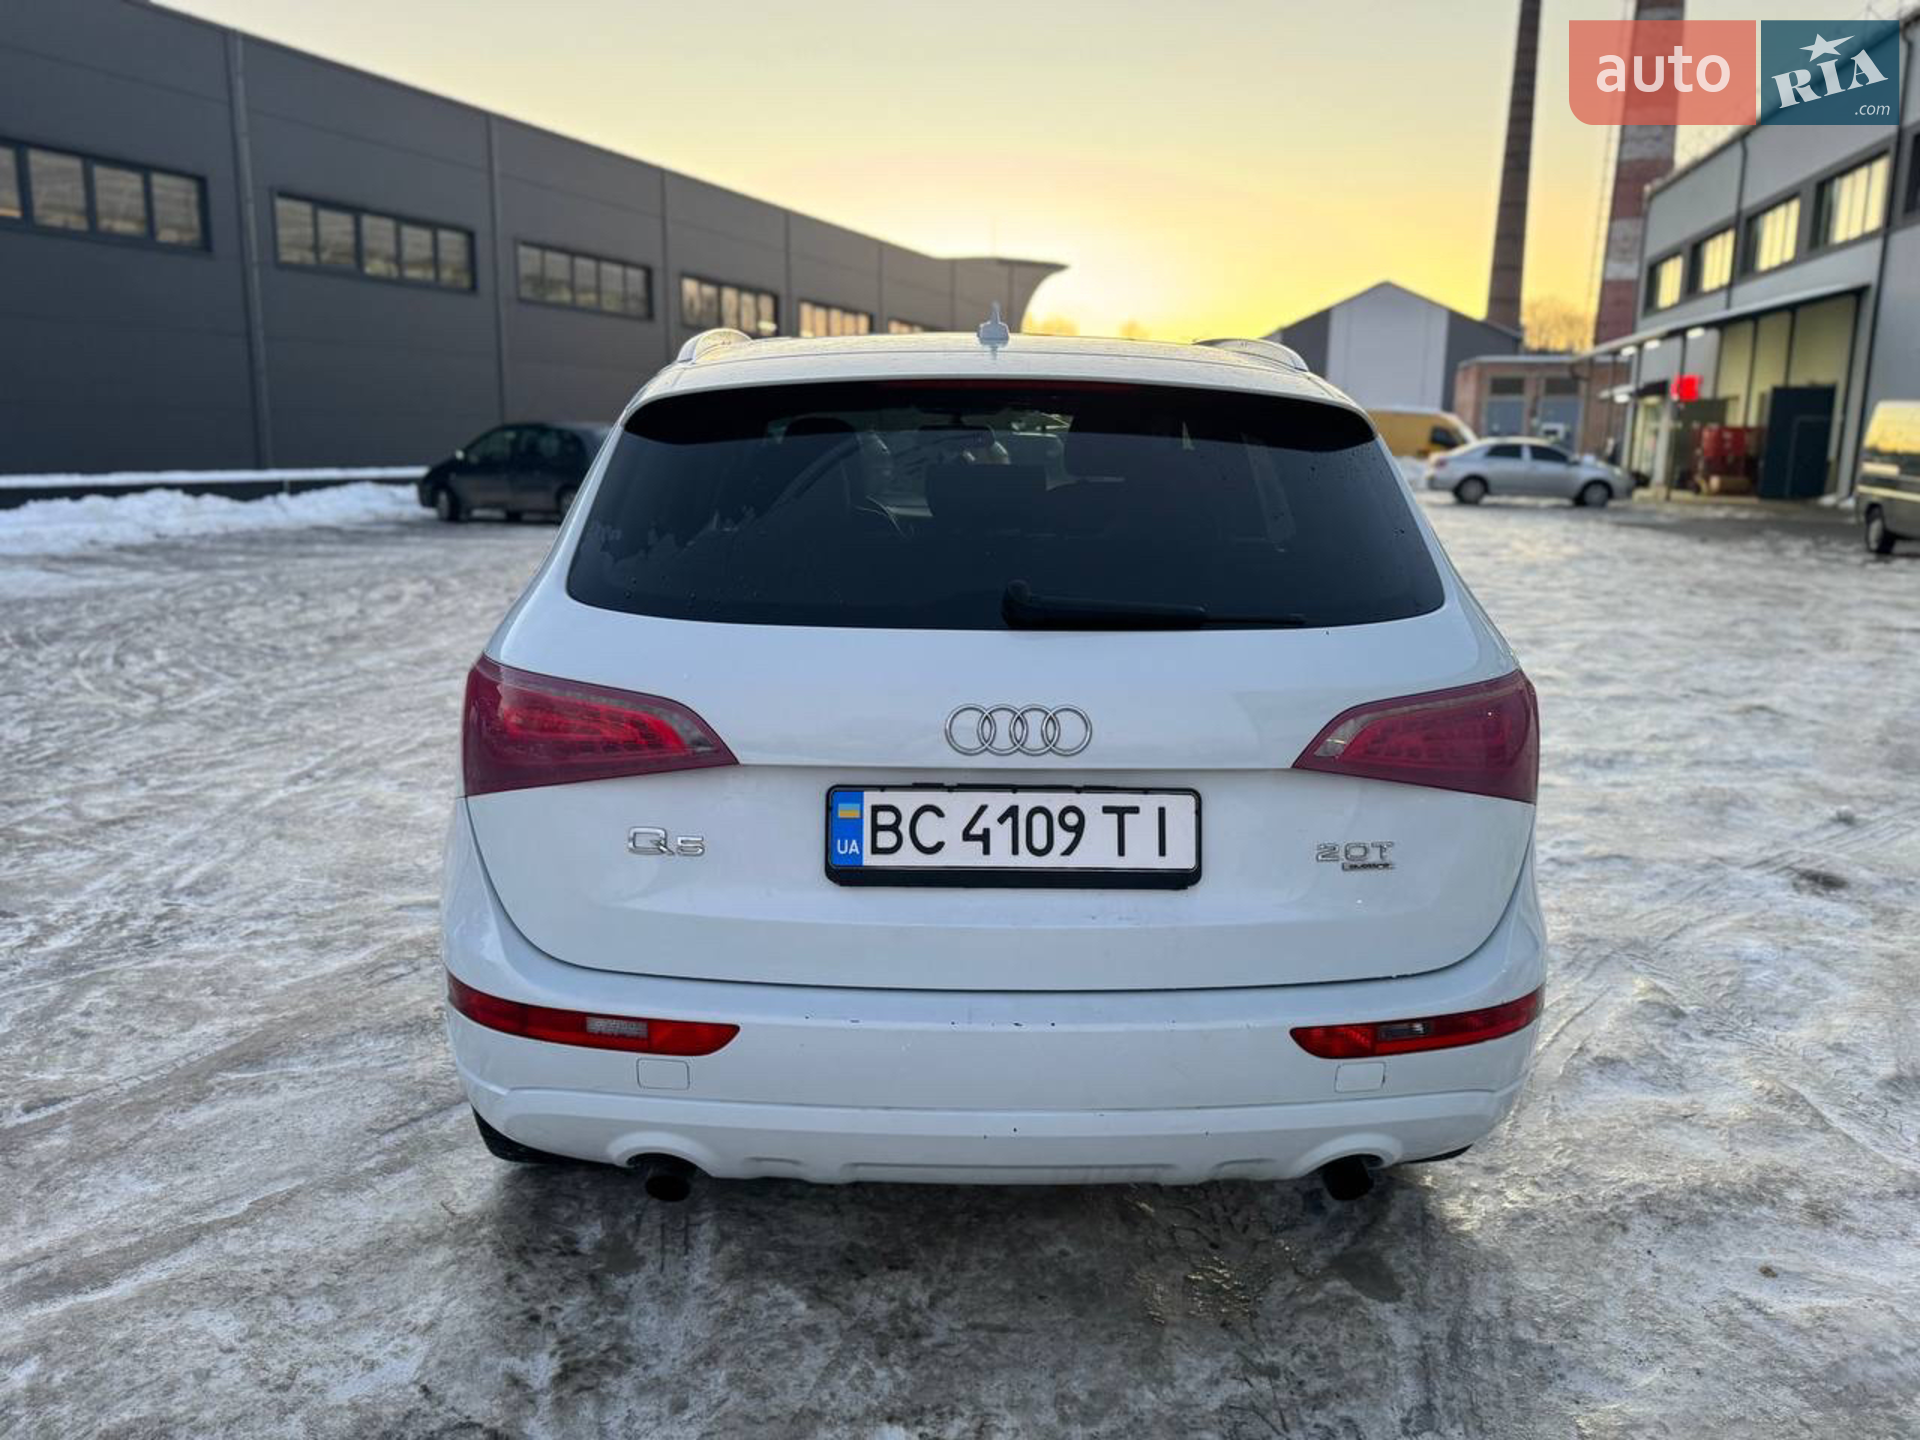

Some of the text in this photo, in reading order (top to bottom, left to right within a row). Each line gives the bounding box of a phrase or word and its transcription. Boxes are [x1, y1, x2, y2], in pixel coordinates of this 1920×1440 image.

[628, 826, 705, 856] Q5
[870, 804, 946, 856] BC
[961, 804, 1086, 857] 4109
[836, 839, 860, 856] UA
